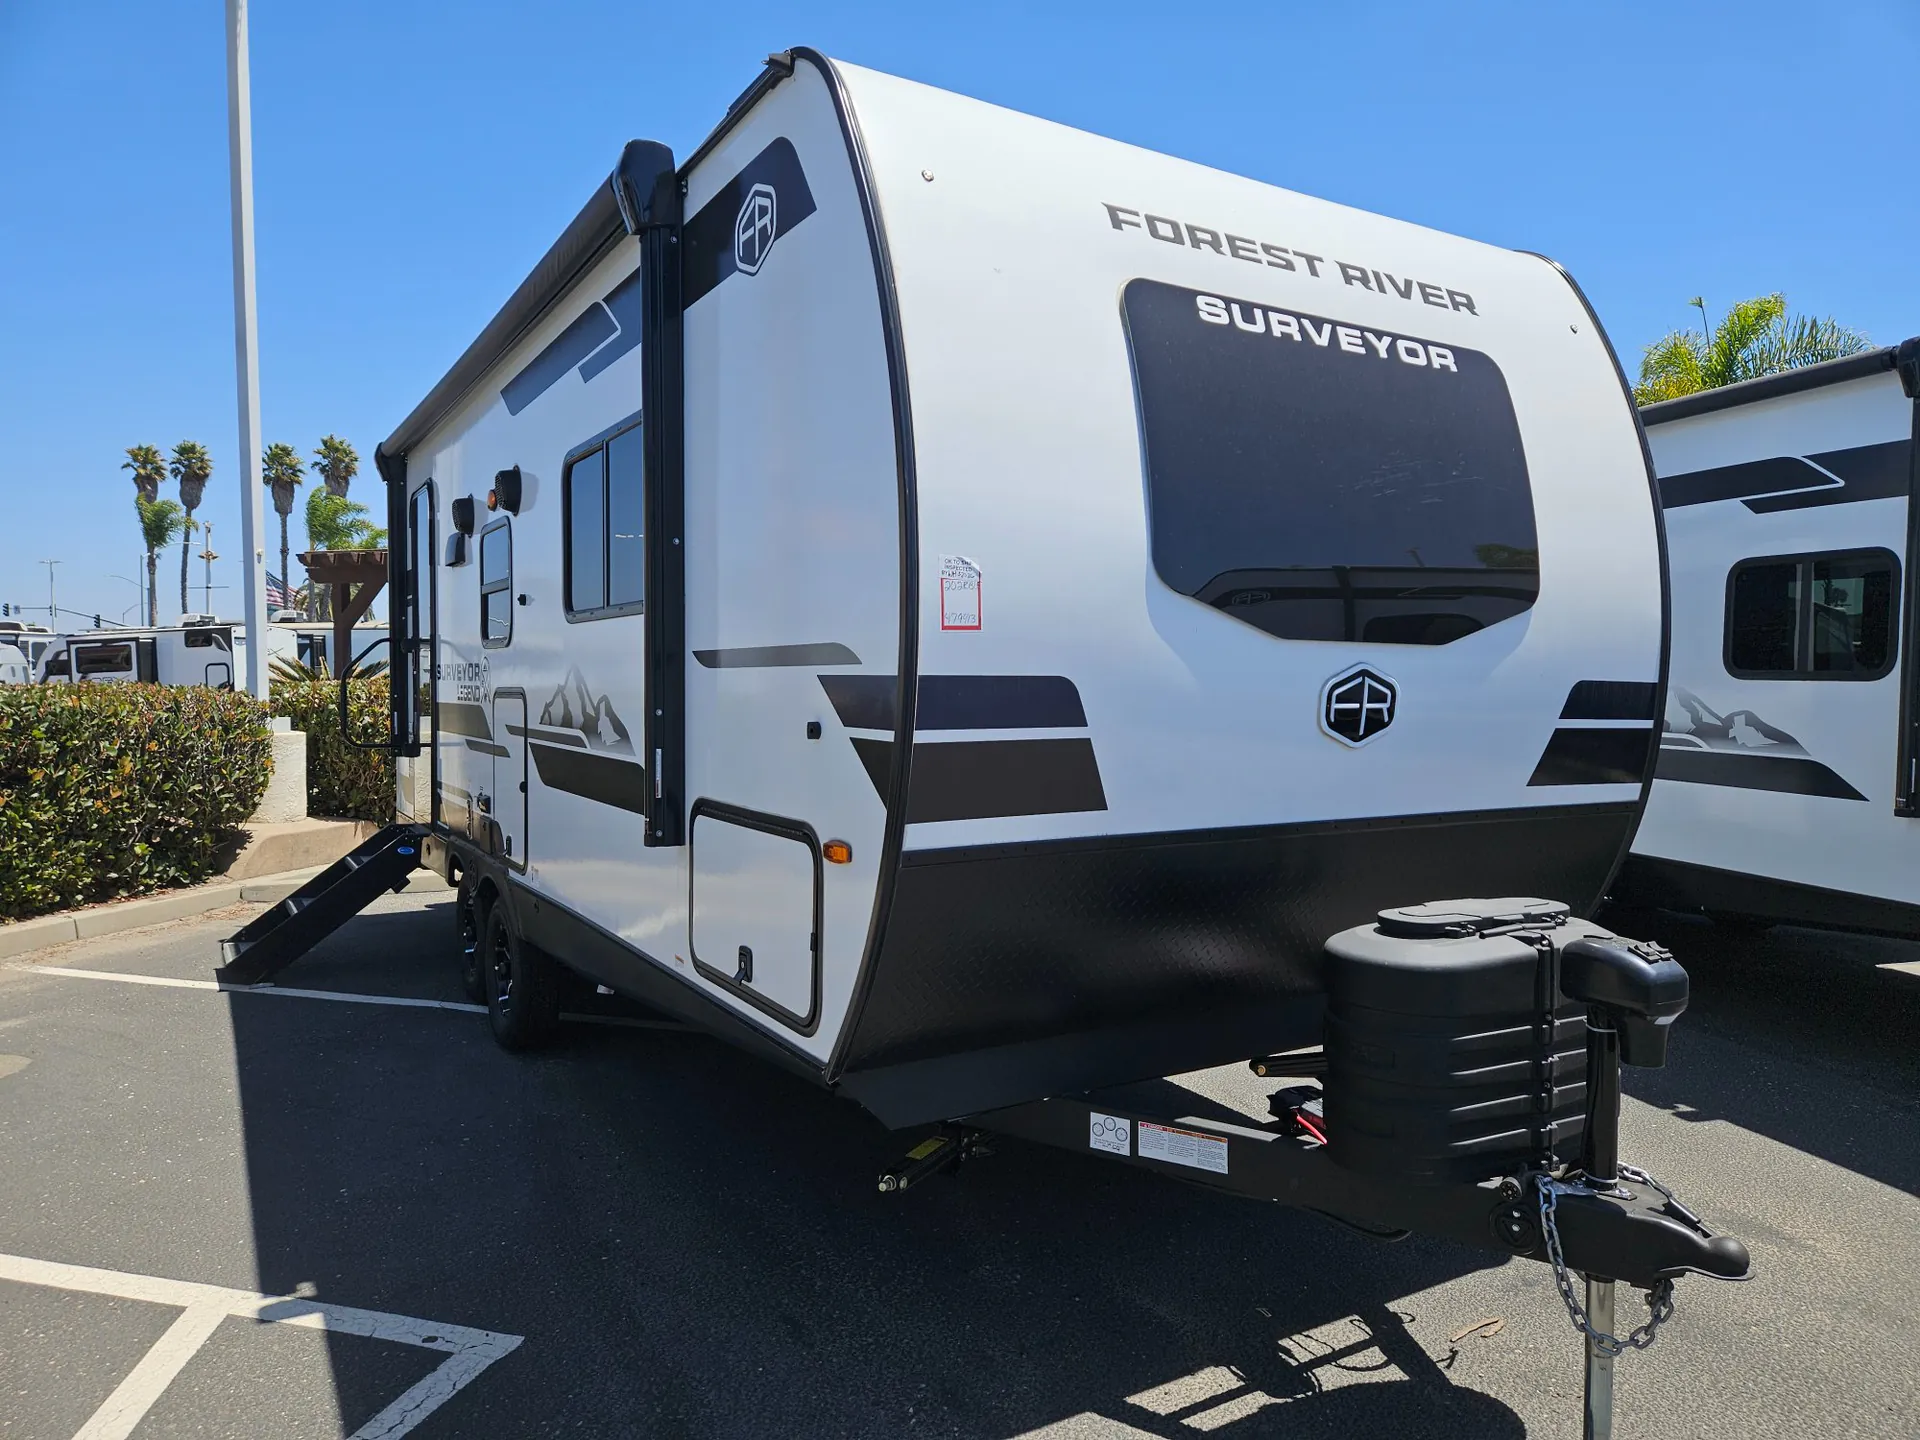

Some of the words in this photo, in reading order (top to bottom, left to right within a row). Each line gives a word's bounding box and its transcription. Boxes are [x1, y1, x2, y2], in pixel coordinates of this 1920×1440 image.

[1101, 202, 1325, 278] FOREST
[1335, 259, 1480, 317] RIVER
[1196, 295, 1459, 373] SURVEYOR
[437, 663, 480, 681] SURVEYOR
[457, 684, 481, 702] LEGEND
